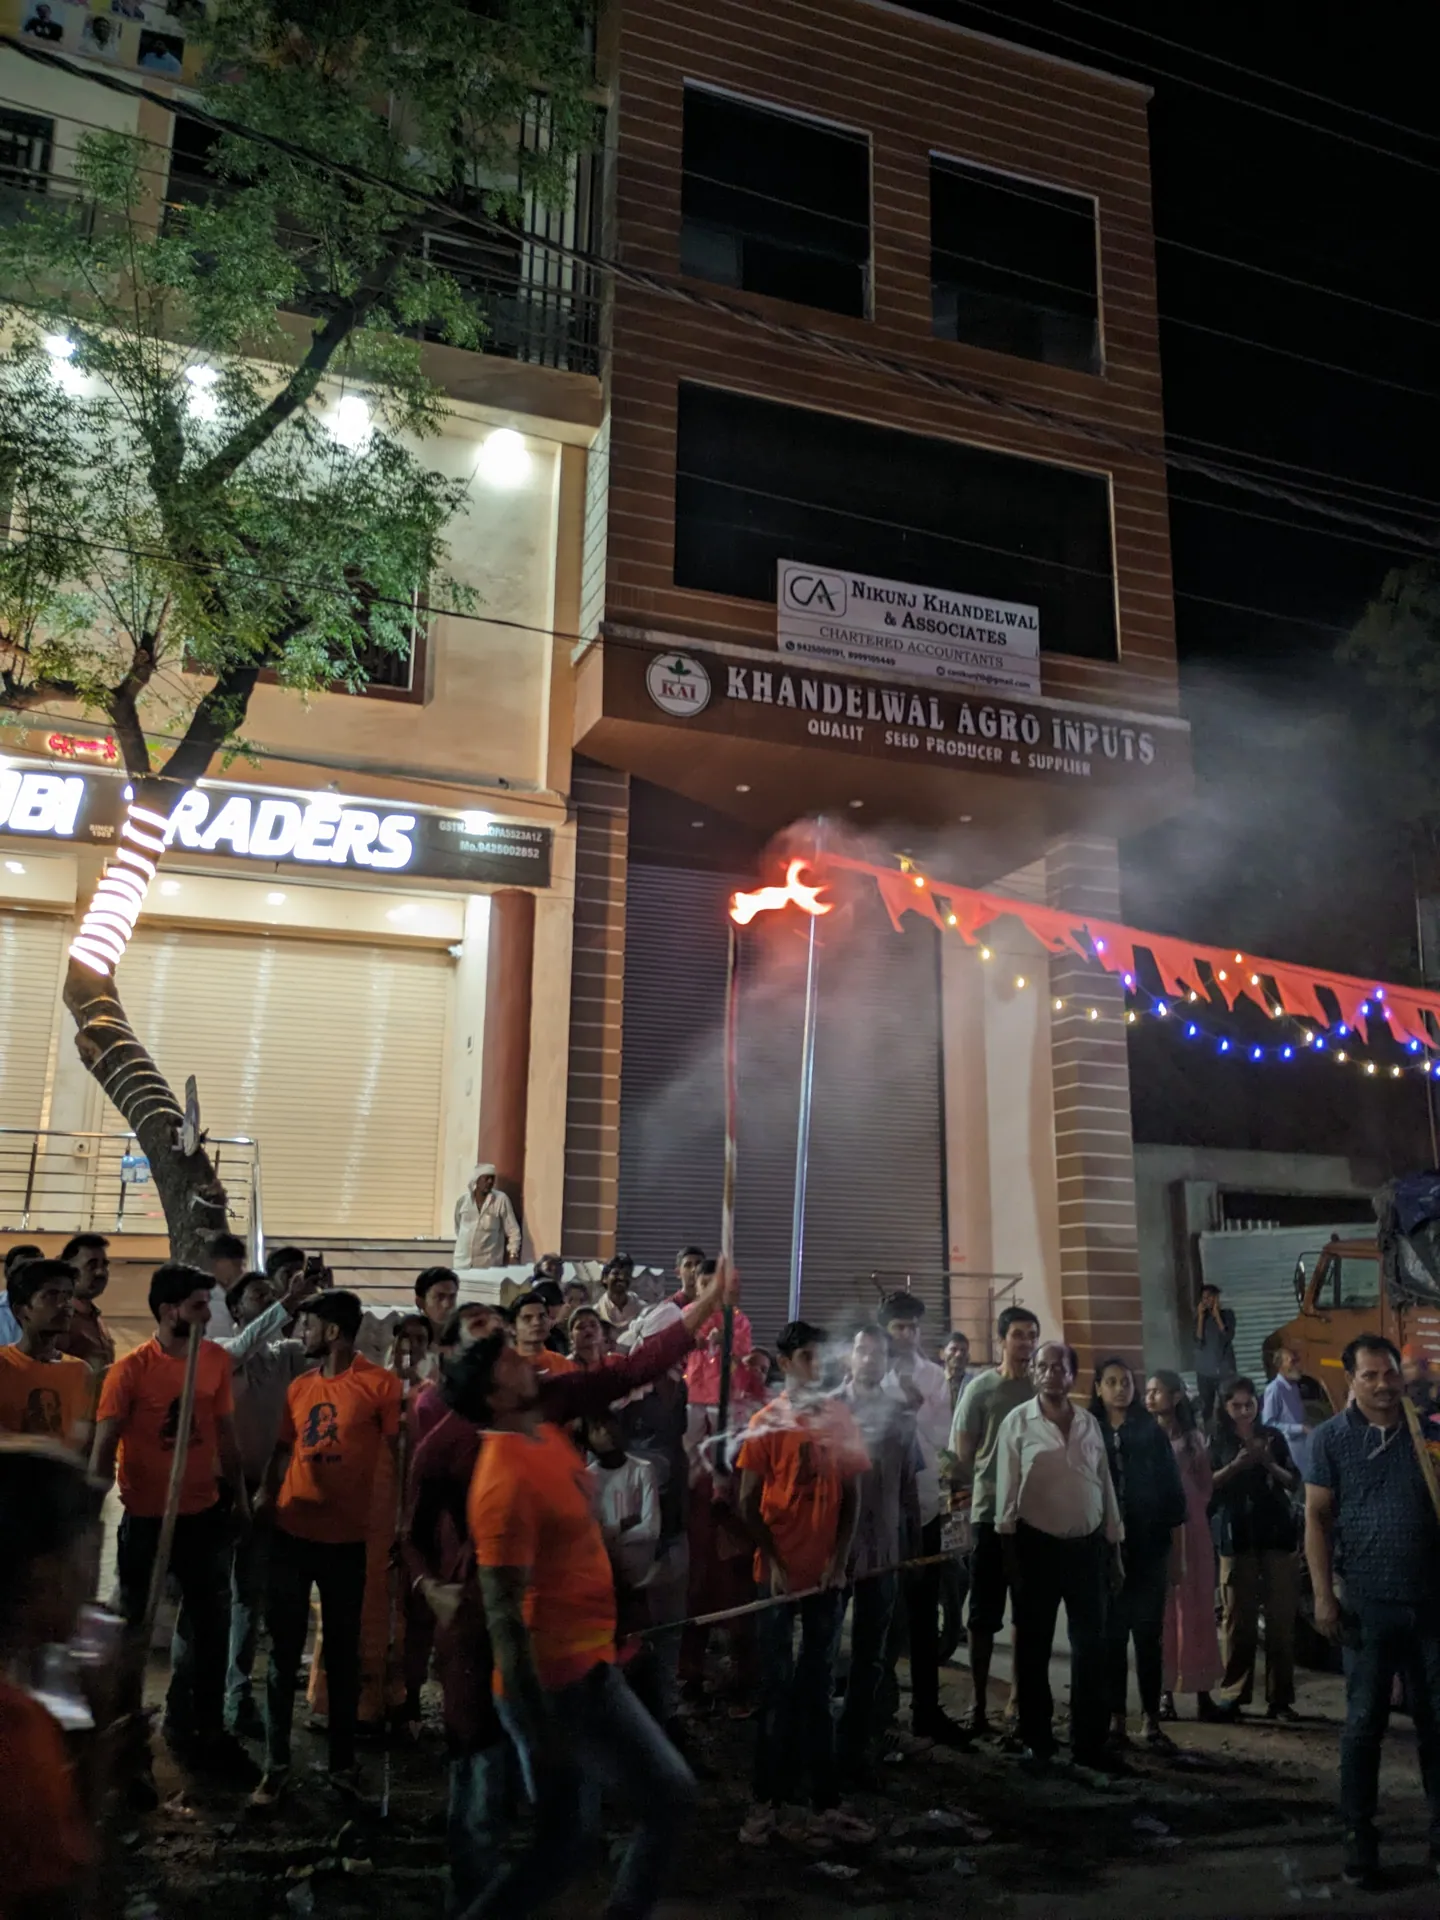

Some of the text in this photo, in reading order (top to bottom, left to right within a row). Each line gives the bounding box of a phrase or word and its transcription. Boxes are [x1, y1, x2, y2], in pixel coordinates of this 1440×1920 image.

[851, 579, 1038, 631] NIKUNJ KHANDELWAL
[819, 626, 1004, 668] CHARTERED ACCOUNTANTS
[884, 611, 1008, 646] & ASSOCIATES
[661, 680, 697, 701] KAI
[726, 665, 1157, 766] KHANDELWAL AGRO INPUTS
[884, 730, 920, 750] SEED
[926, 736, 1004, 763] PRODUCER
[1010, 750, 1021, 765] &
[1028, 753, 1092, 777] SUPPLIER
